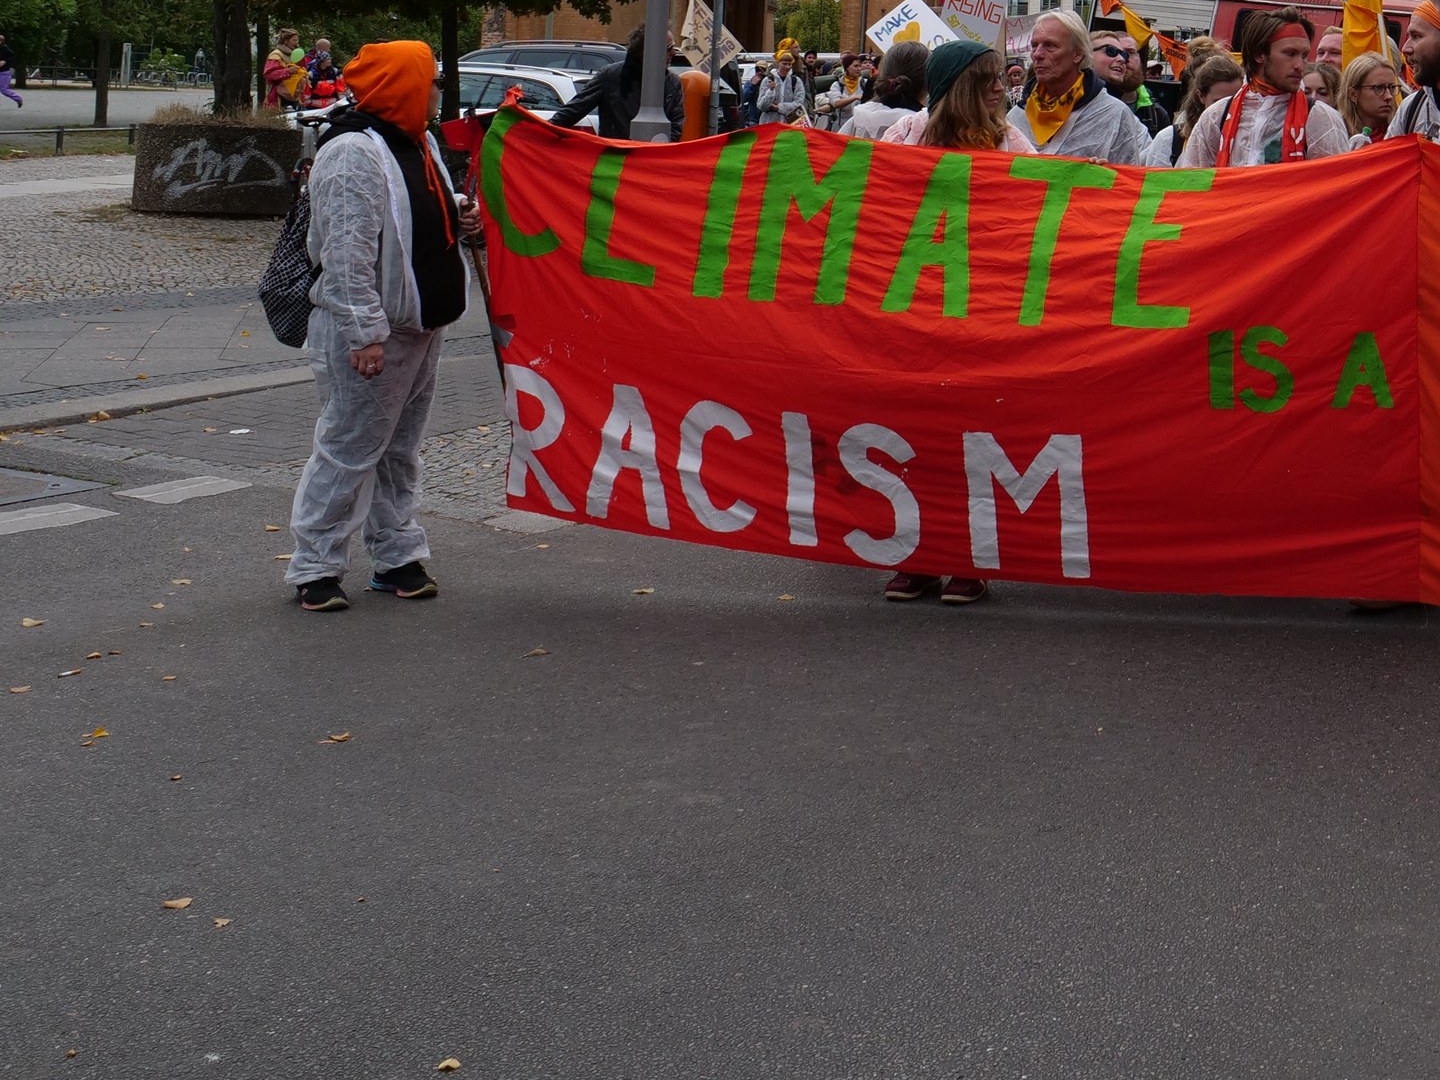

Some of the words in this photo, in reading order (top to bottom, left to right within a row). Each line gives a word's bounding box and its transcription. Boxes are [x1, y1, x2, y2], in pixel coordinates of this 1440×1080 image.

[874, 4, 919, 42] MAKE
[480, 106, 1216, 329] CLIMATE
[1206, 325, 1295, 414] IS
[1331, 331, 1395, 410] A
[504, 362, 1092, 579] RACISM
